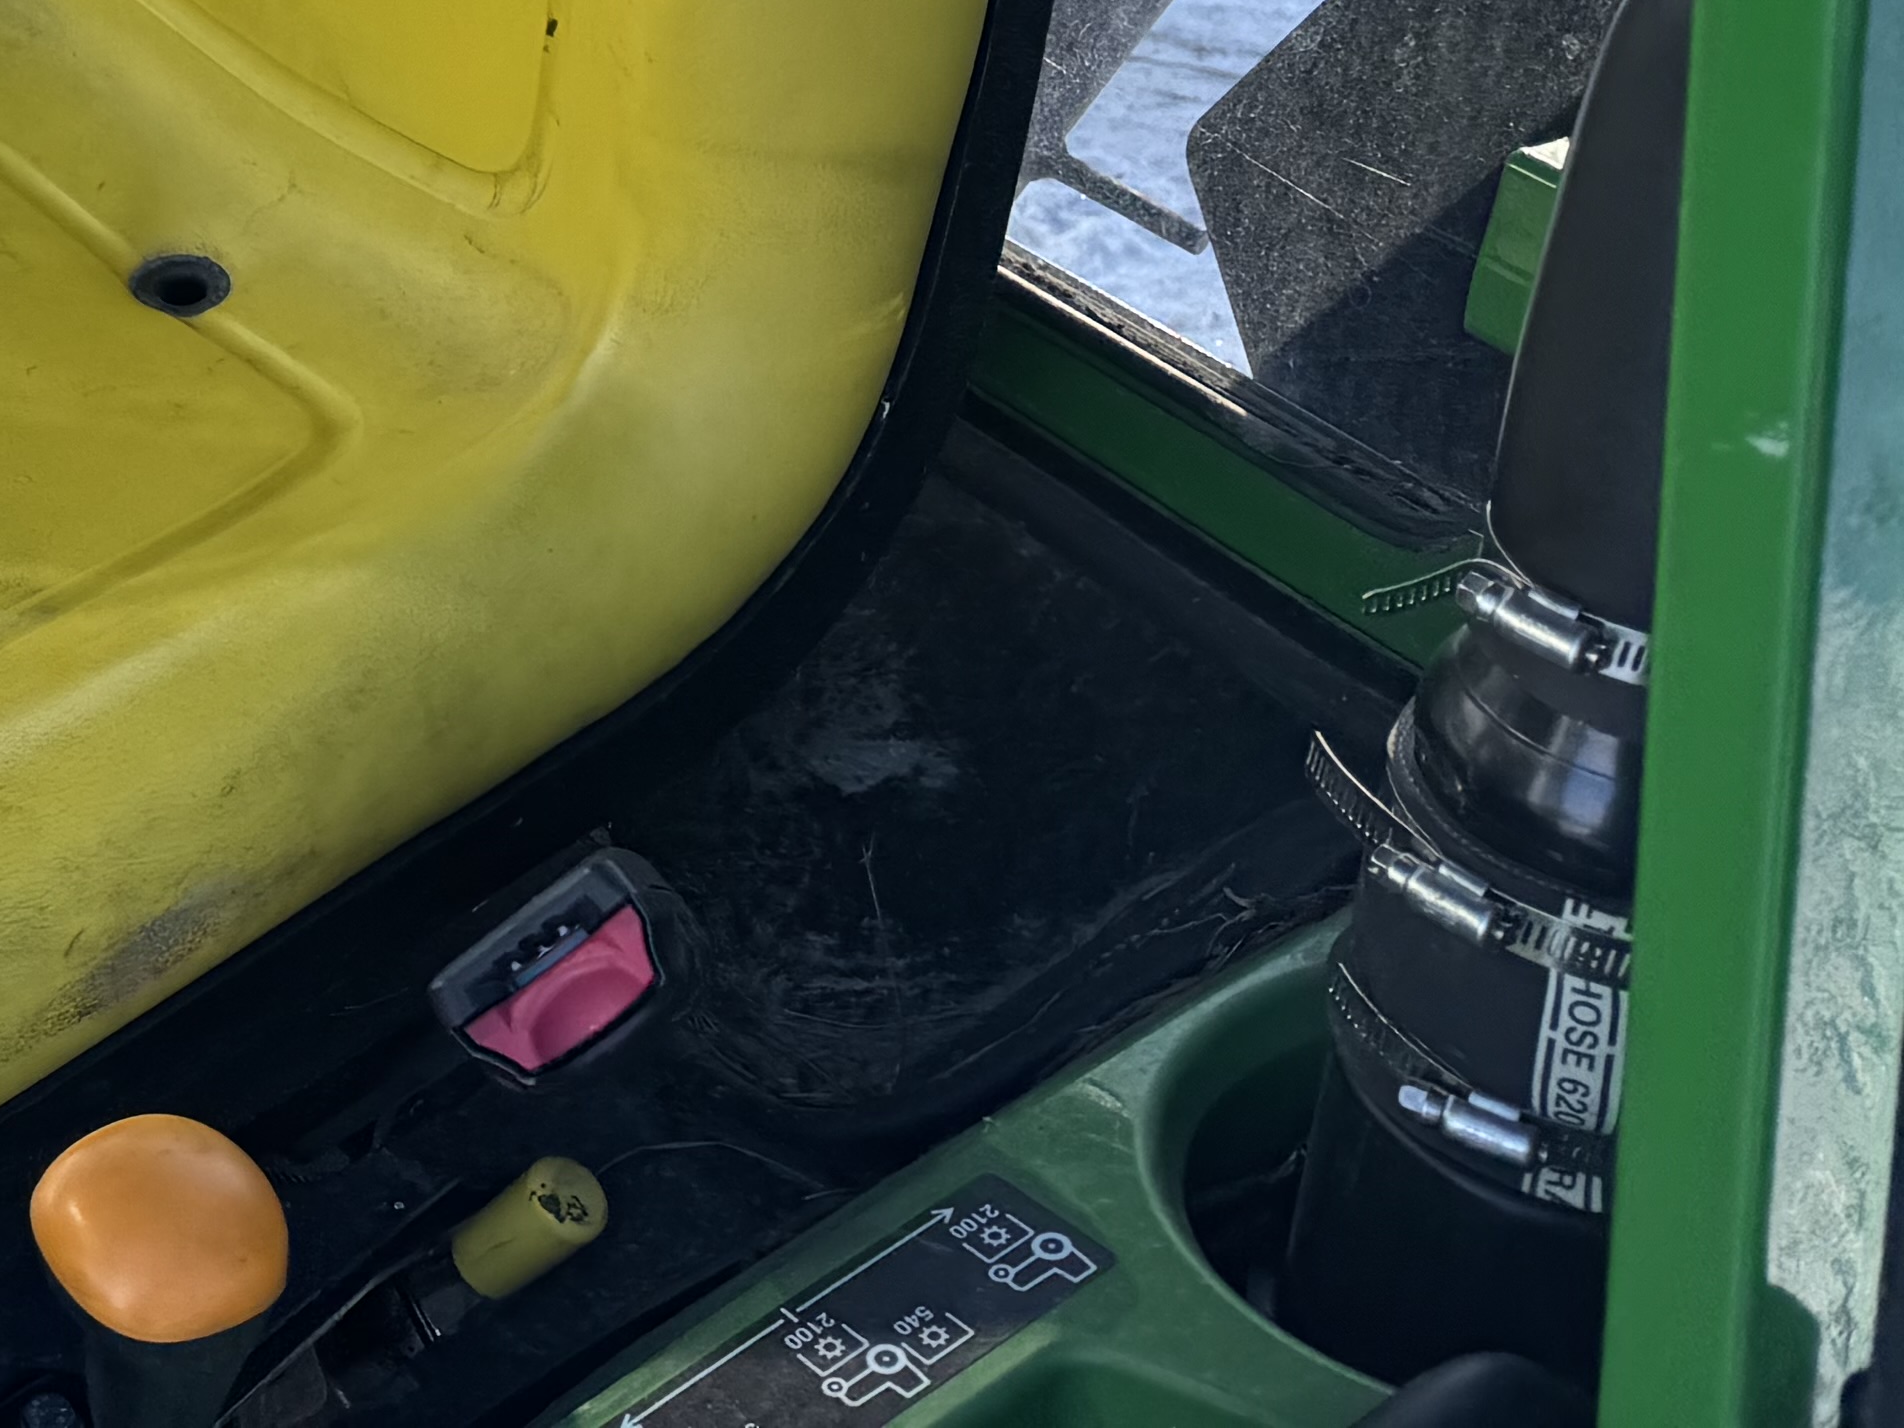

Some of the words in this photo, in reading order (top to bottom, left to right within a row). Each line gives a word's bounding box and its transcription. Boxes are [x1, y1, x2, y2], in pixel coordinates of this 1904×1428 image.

[949, 1203, 1000, 1239] 2100
[784, 1312, 835, 1349] 2100
[893, 1305, 935, 1335] 540
